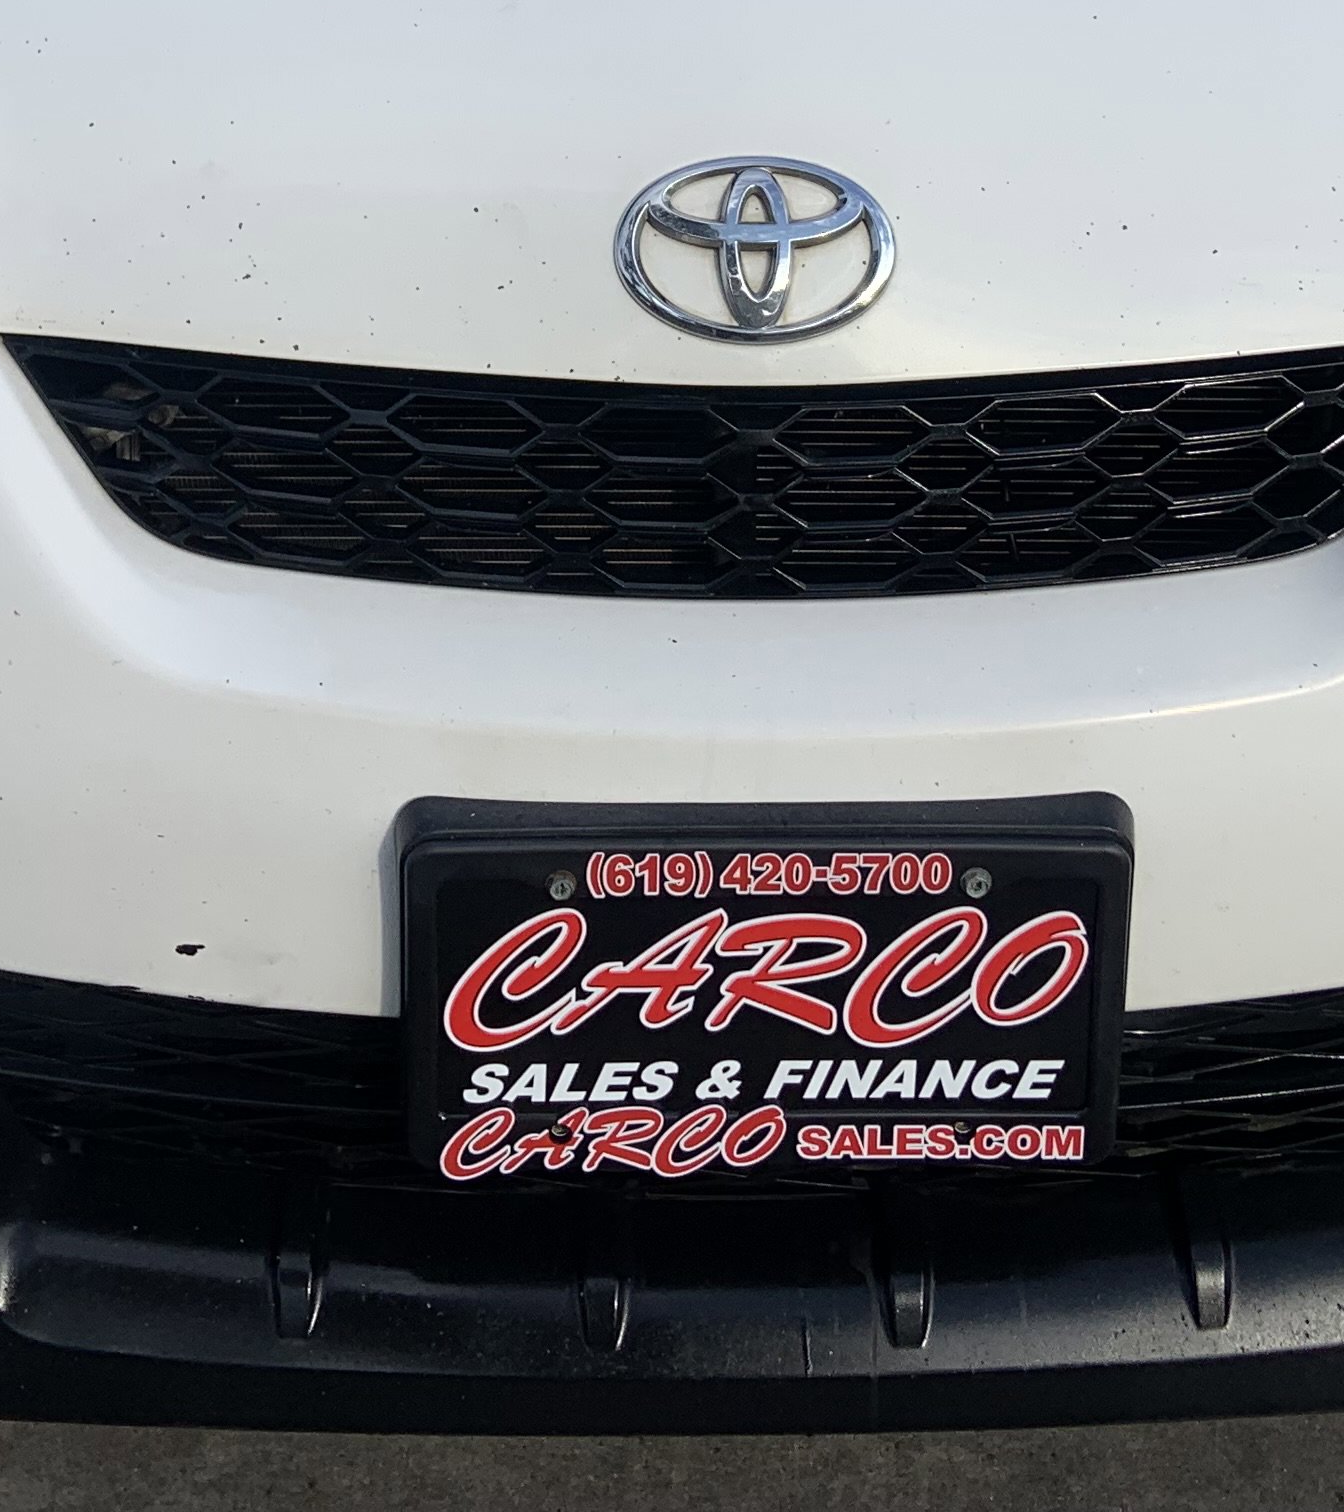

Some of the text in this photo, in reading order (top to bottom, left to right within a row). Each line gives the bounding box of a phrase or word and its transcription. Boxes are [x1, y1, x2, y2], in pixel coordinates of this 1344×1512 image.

[585, 851, 953, 898] (619) 420-5700
[443, 906, 1089, 1053] CARCO
[462, 1058, 1066, 1105] SALES & FINANCE
[439, 1104, 1086, 1181] CARCO SALES.COM
